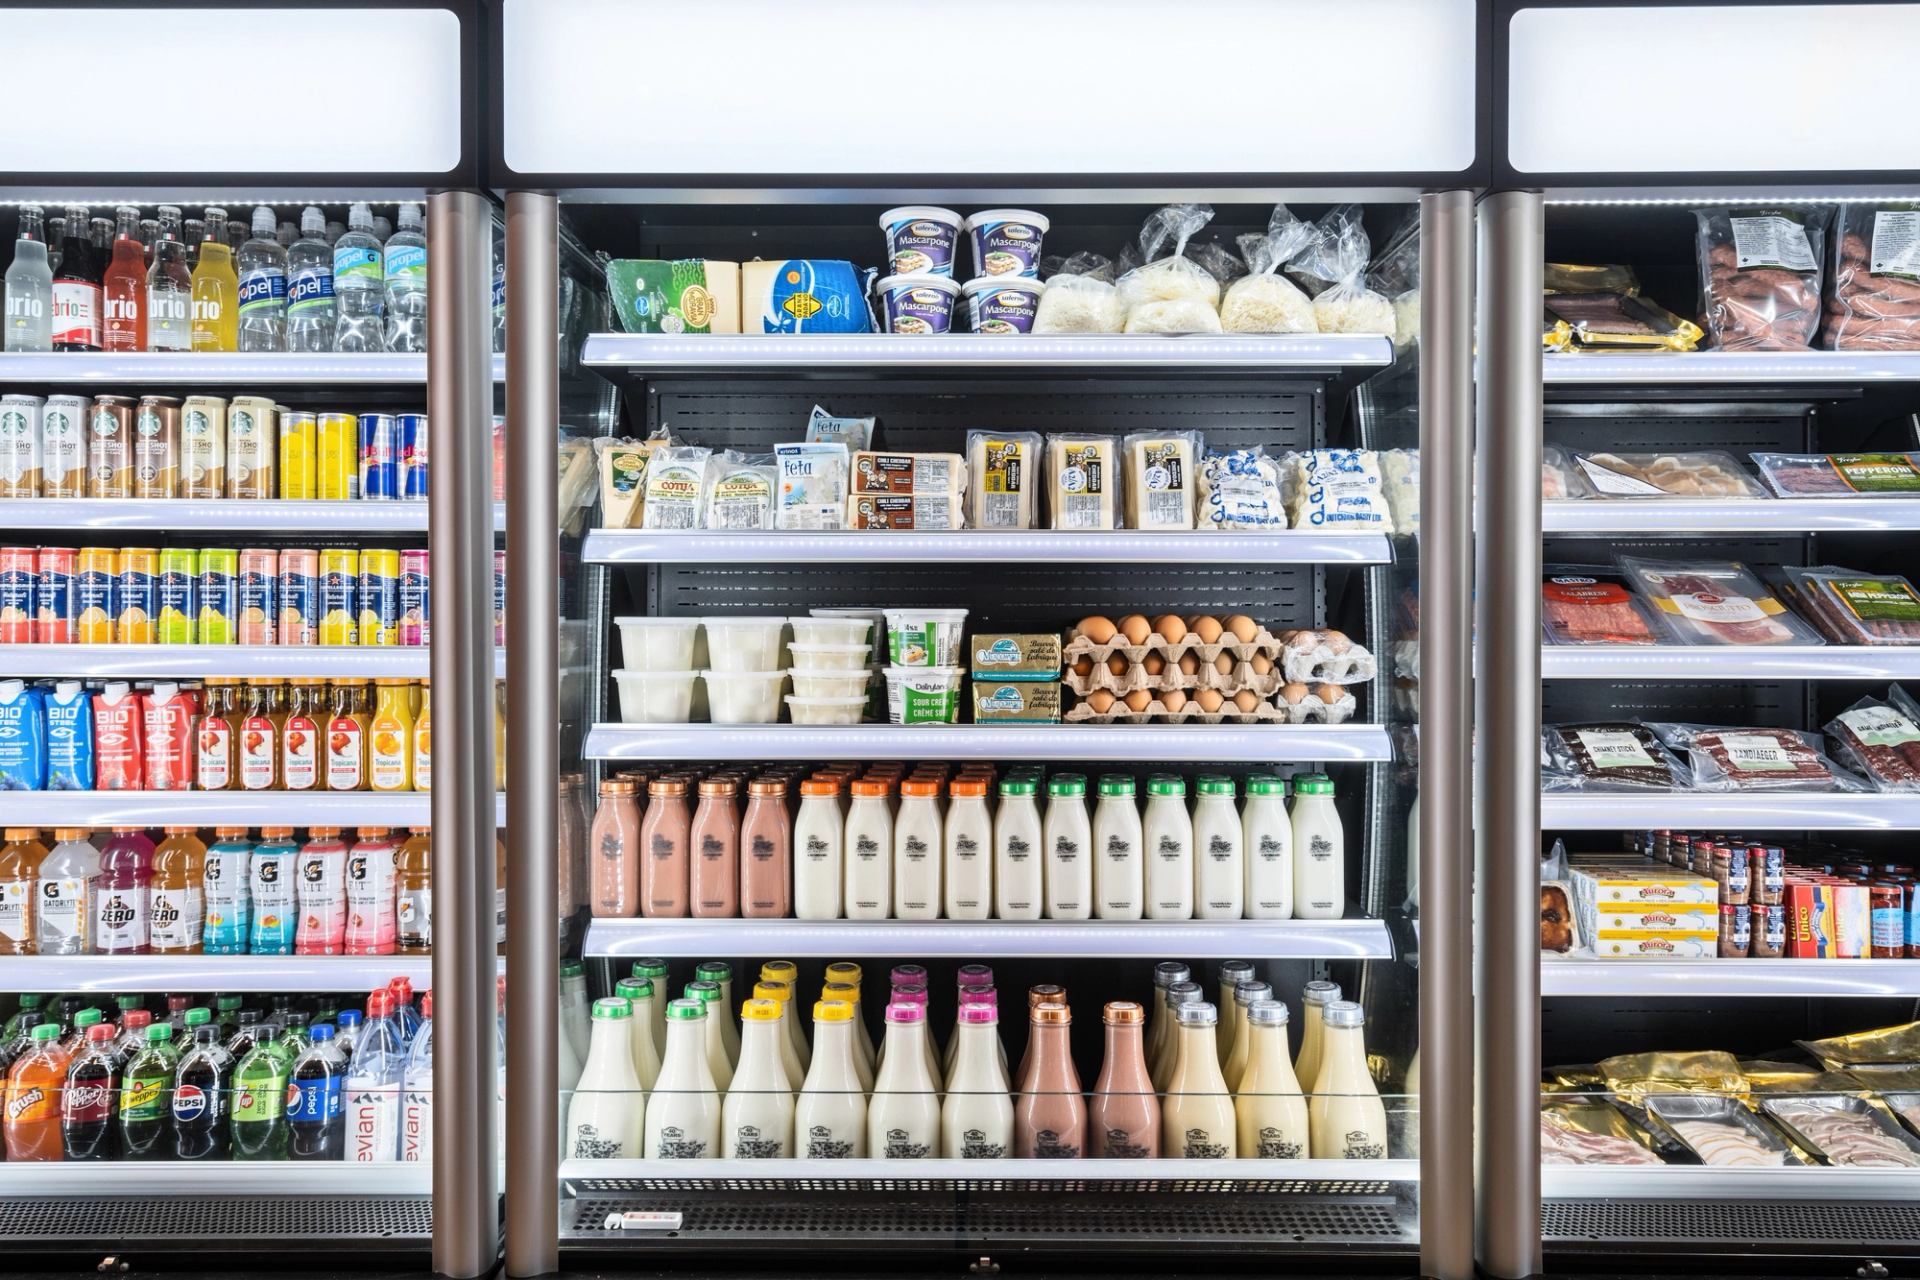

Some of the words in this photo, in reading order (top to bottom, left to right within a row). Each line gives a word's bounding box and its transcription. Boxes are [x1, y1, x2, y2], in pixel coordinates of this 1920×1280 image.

[899, 236, 950, 248] Mascarpone
[6, 282, 43, 318] brio
[54, 292, 79, 318] brio
[898, 302, 948, 314] Mascarpone
[985, 305, 1035, 317] Mascarpone
[816, 418, 841, 433] feta
[784, 459, 812, 476] feta
[1844, 466, 1913, 475] PEPPERONI
[913, 698, 930, 706] SOUR
[49, 707, 78, 719] BIO
[96, 710, 128, 723] BIO
[145, 710, 176, 723] BIO
[913, 708, 934, 717] CRÈME
[44, 882, 60, 899] G
[101, 909, 136, 922] ZERO
[1799, 906, 1811, 942] Unico
[9, 1089, 44, 1118] Crush
[174, 1099, 204, 1108] PEPSI
[307, 1086, 318, 1115] pepsi
[358, 1106, 375, 1161] evian
[406, 1106, 419, 1161] evian
